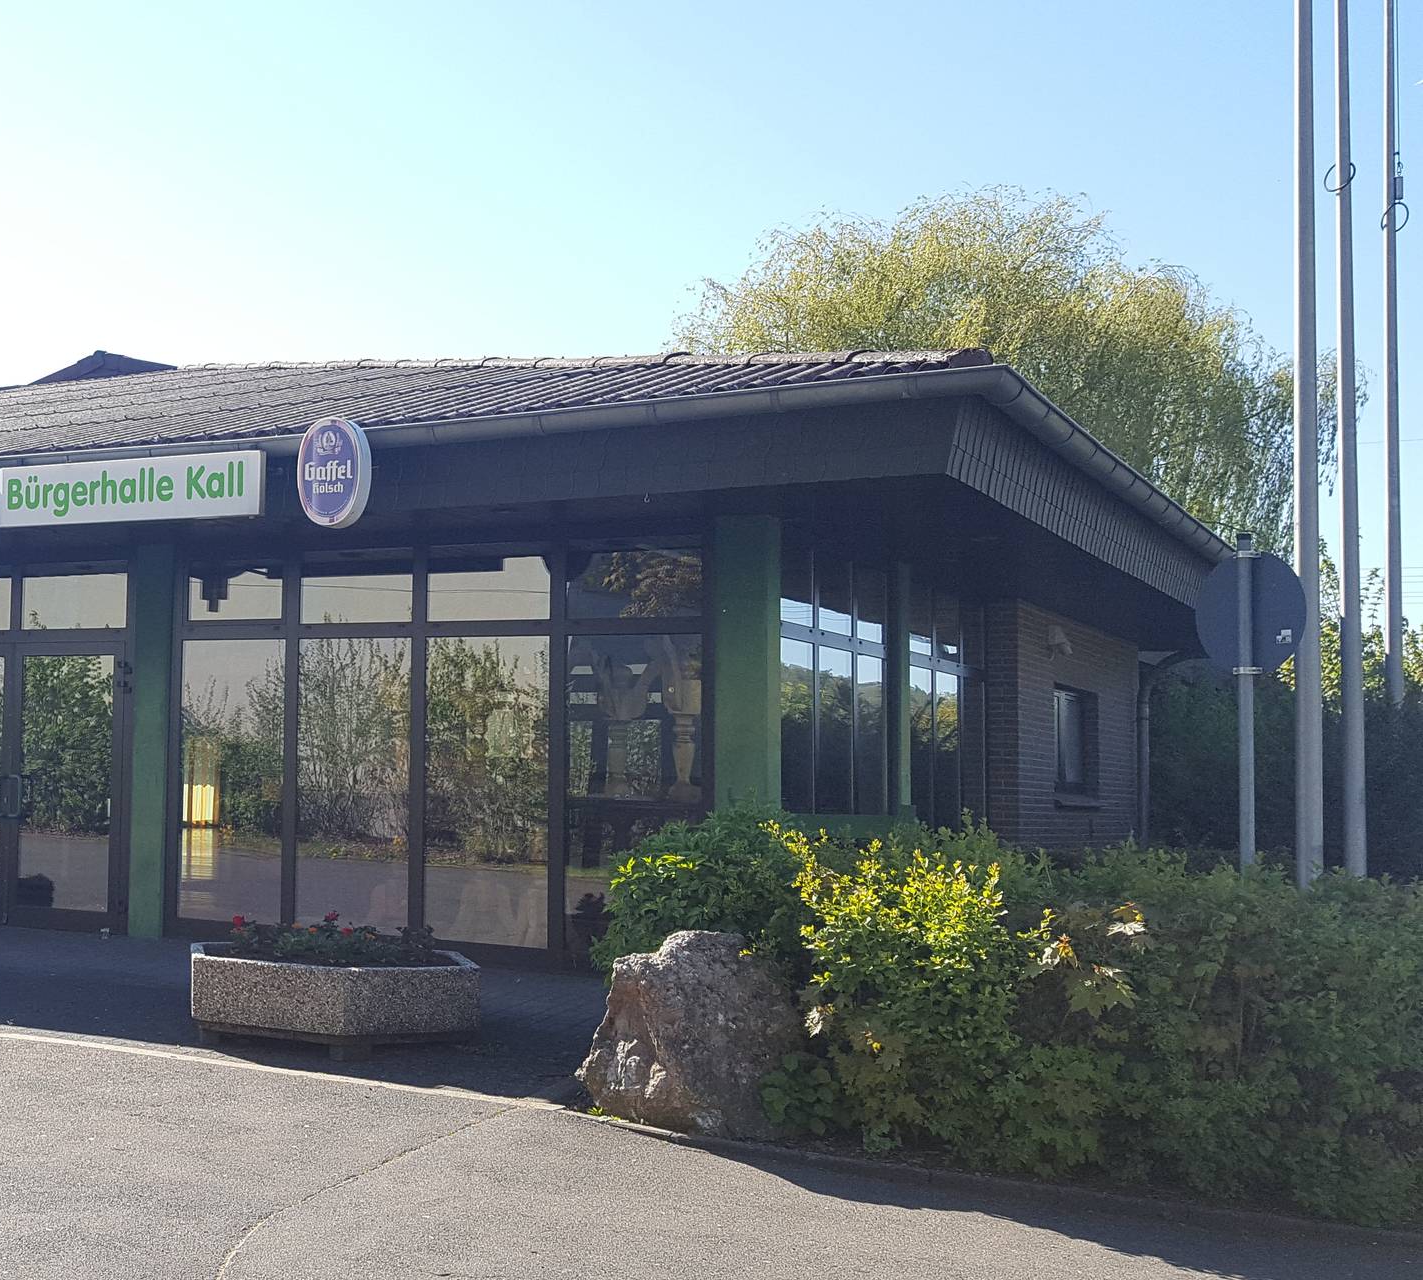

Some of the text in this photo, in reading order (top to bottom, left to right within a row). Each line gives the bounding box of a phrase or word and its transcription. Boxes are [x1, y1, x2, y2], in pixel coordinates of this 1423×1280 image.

[304, 460, 353, 481] Gaffel
[7, 460, 244, 517] Bürgerhalle Kall
[312, 481, 344, 494] Kölsch
